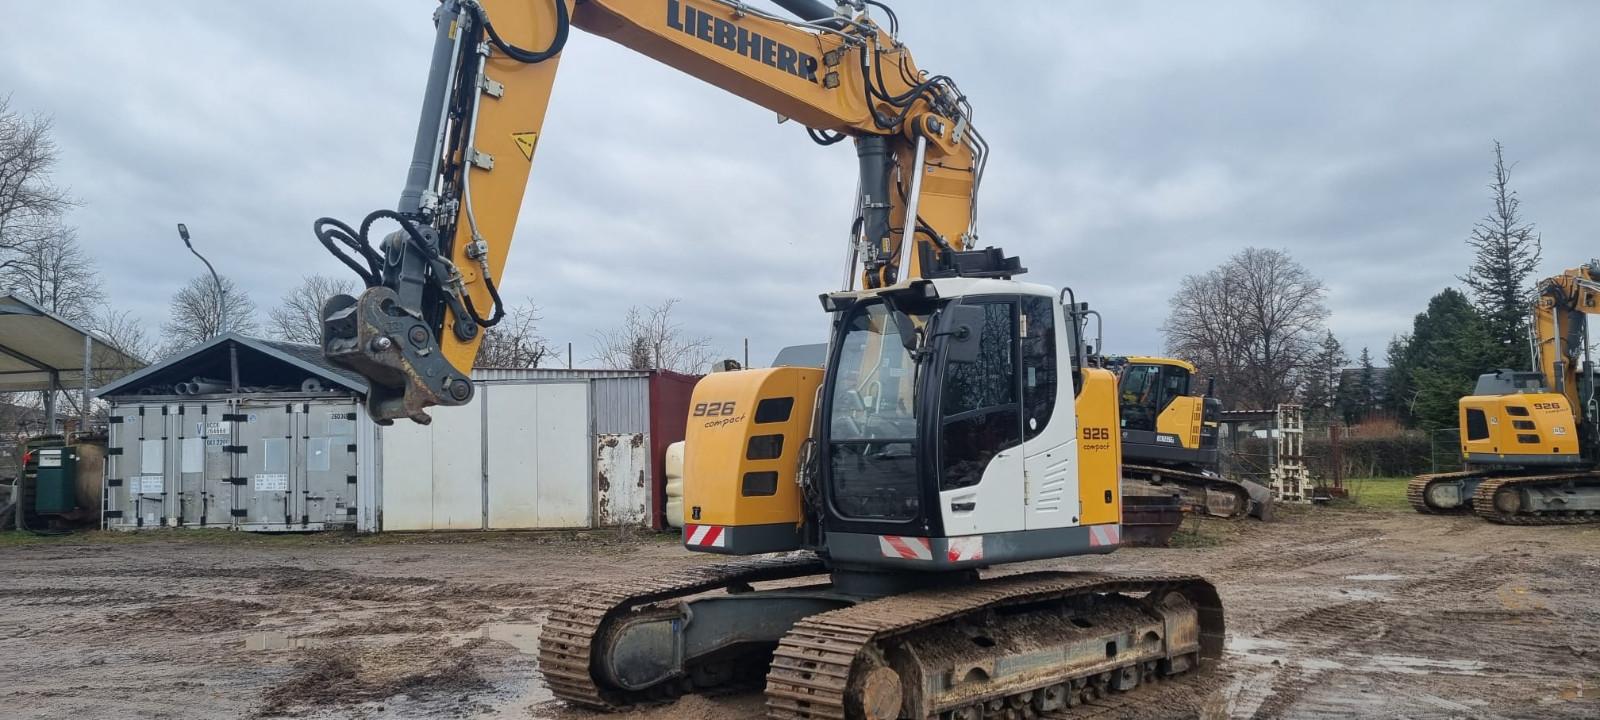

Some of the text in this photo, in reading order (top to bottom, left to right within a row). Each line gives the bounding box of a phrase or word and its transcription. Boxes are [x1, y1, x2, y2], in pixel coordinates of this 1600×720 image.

[667, 0, 818, 84] LIEBHERR
[693, 401, 736, 417] 926
[1534, 402, 1560, 410] 926
[704, 412, 746, 428] compact
[1083, 428, 1109, 440] 926
[1083, 442, 1110, 453] compact
